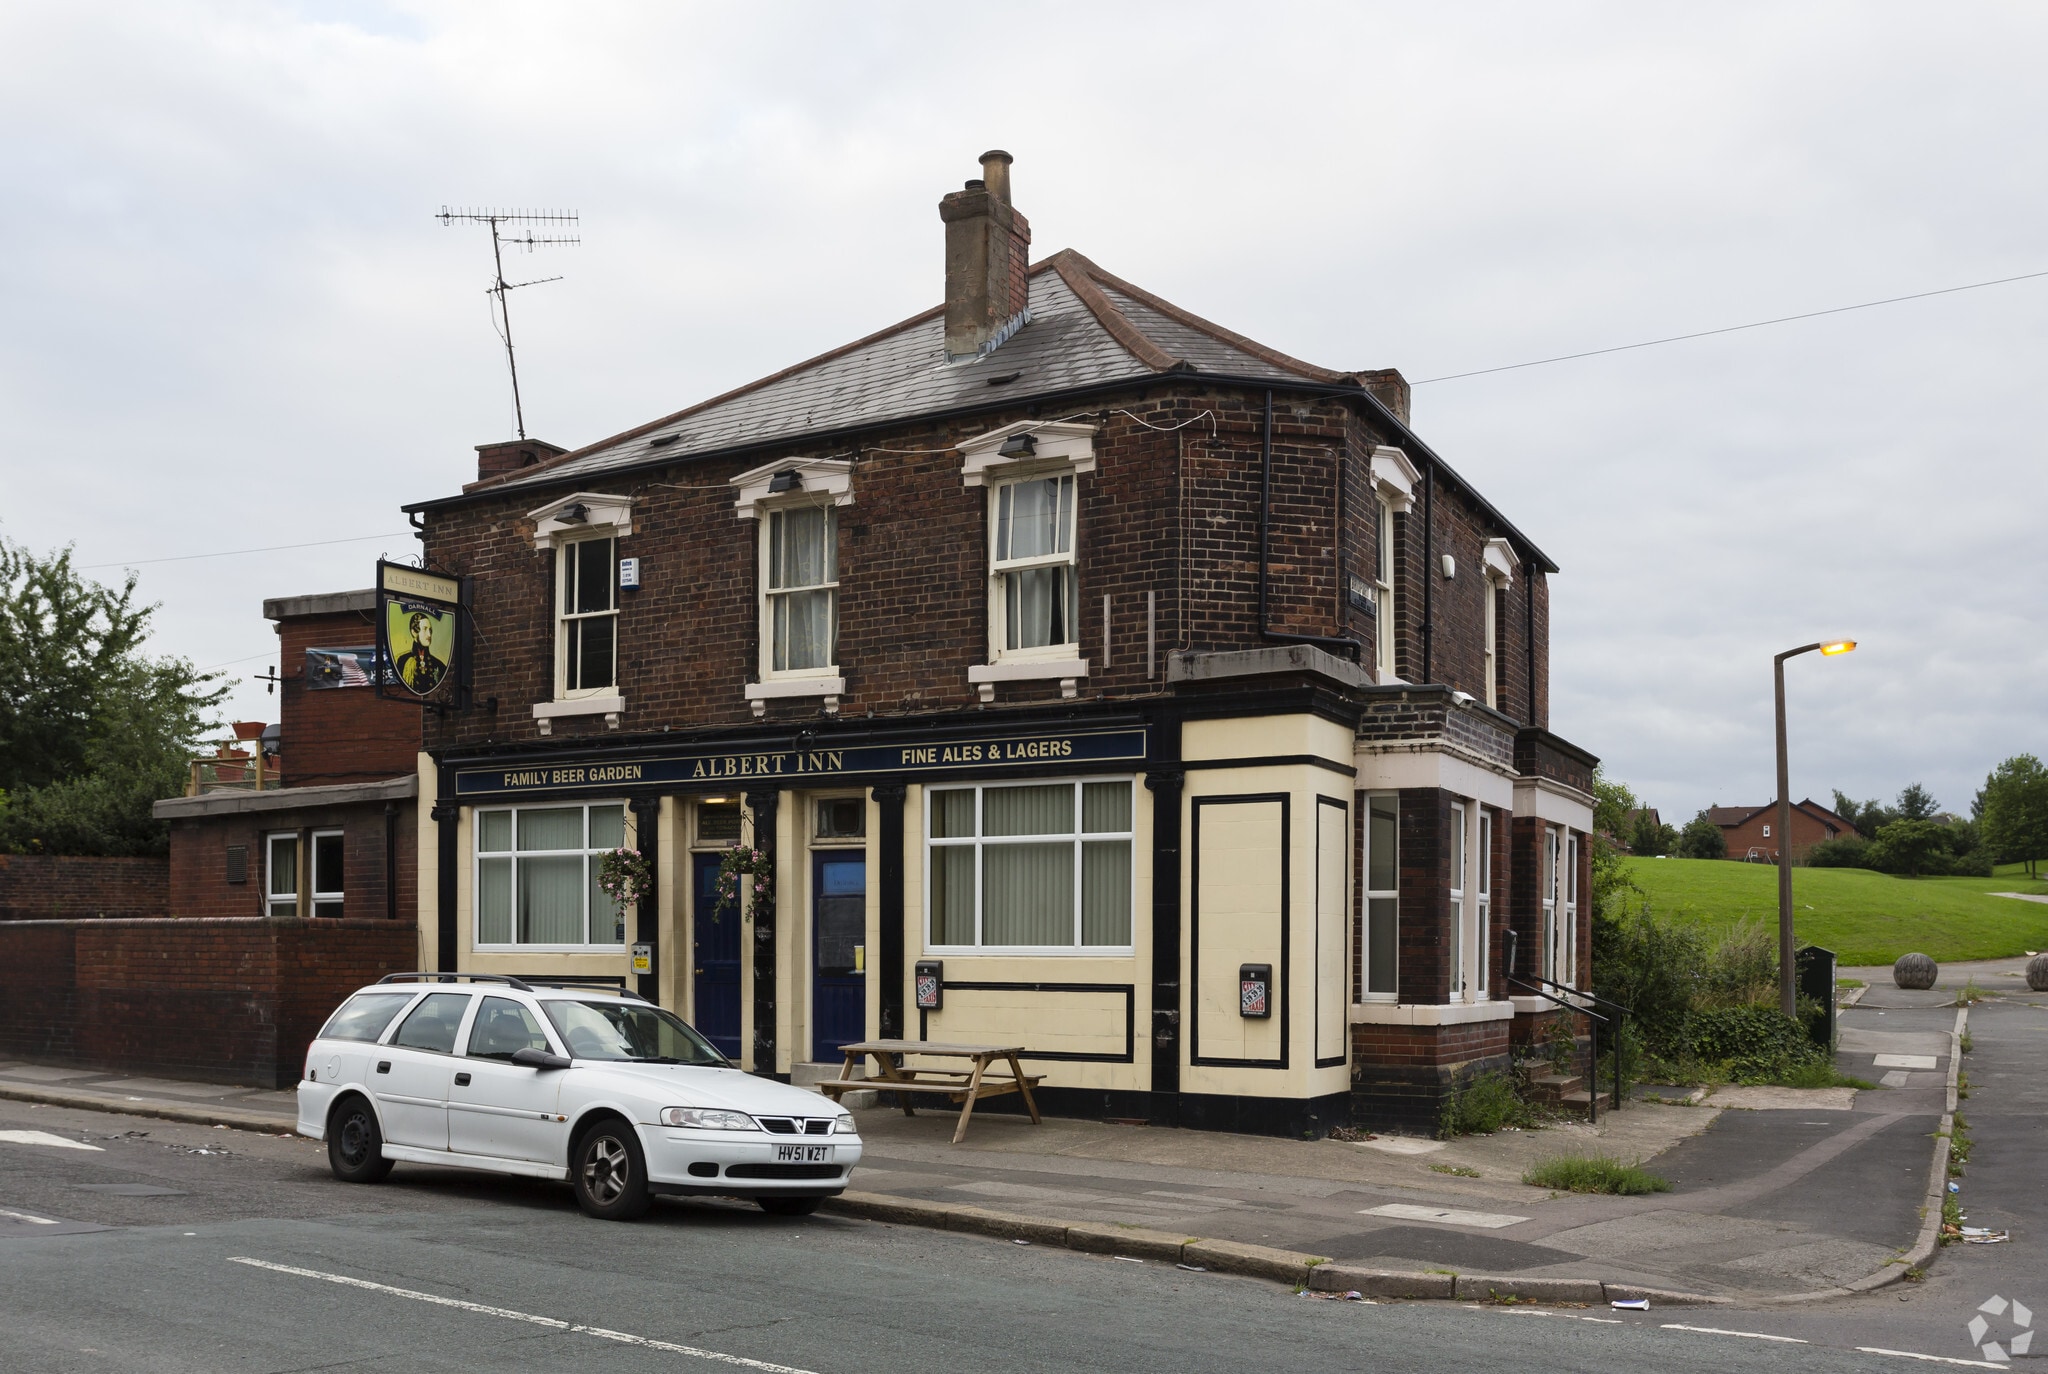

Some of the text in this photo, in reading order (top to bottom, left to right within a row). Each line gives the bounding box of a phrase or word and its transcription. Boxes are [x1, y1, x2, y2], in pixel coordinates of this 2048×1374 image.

[388, 575, 453, 595] ALBERT INN
[408, 604, 436, 615] DARNALL
[901, 740, 1072, 765] FINE ALES & LAGERS
[692, 751, 844, 778] ALBERT INN
[504, 765, 642, 787] FAMILY BEER GARDEN
[778, 1146, 828, 1161] HV51 WZT
